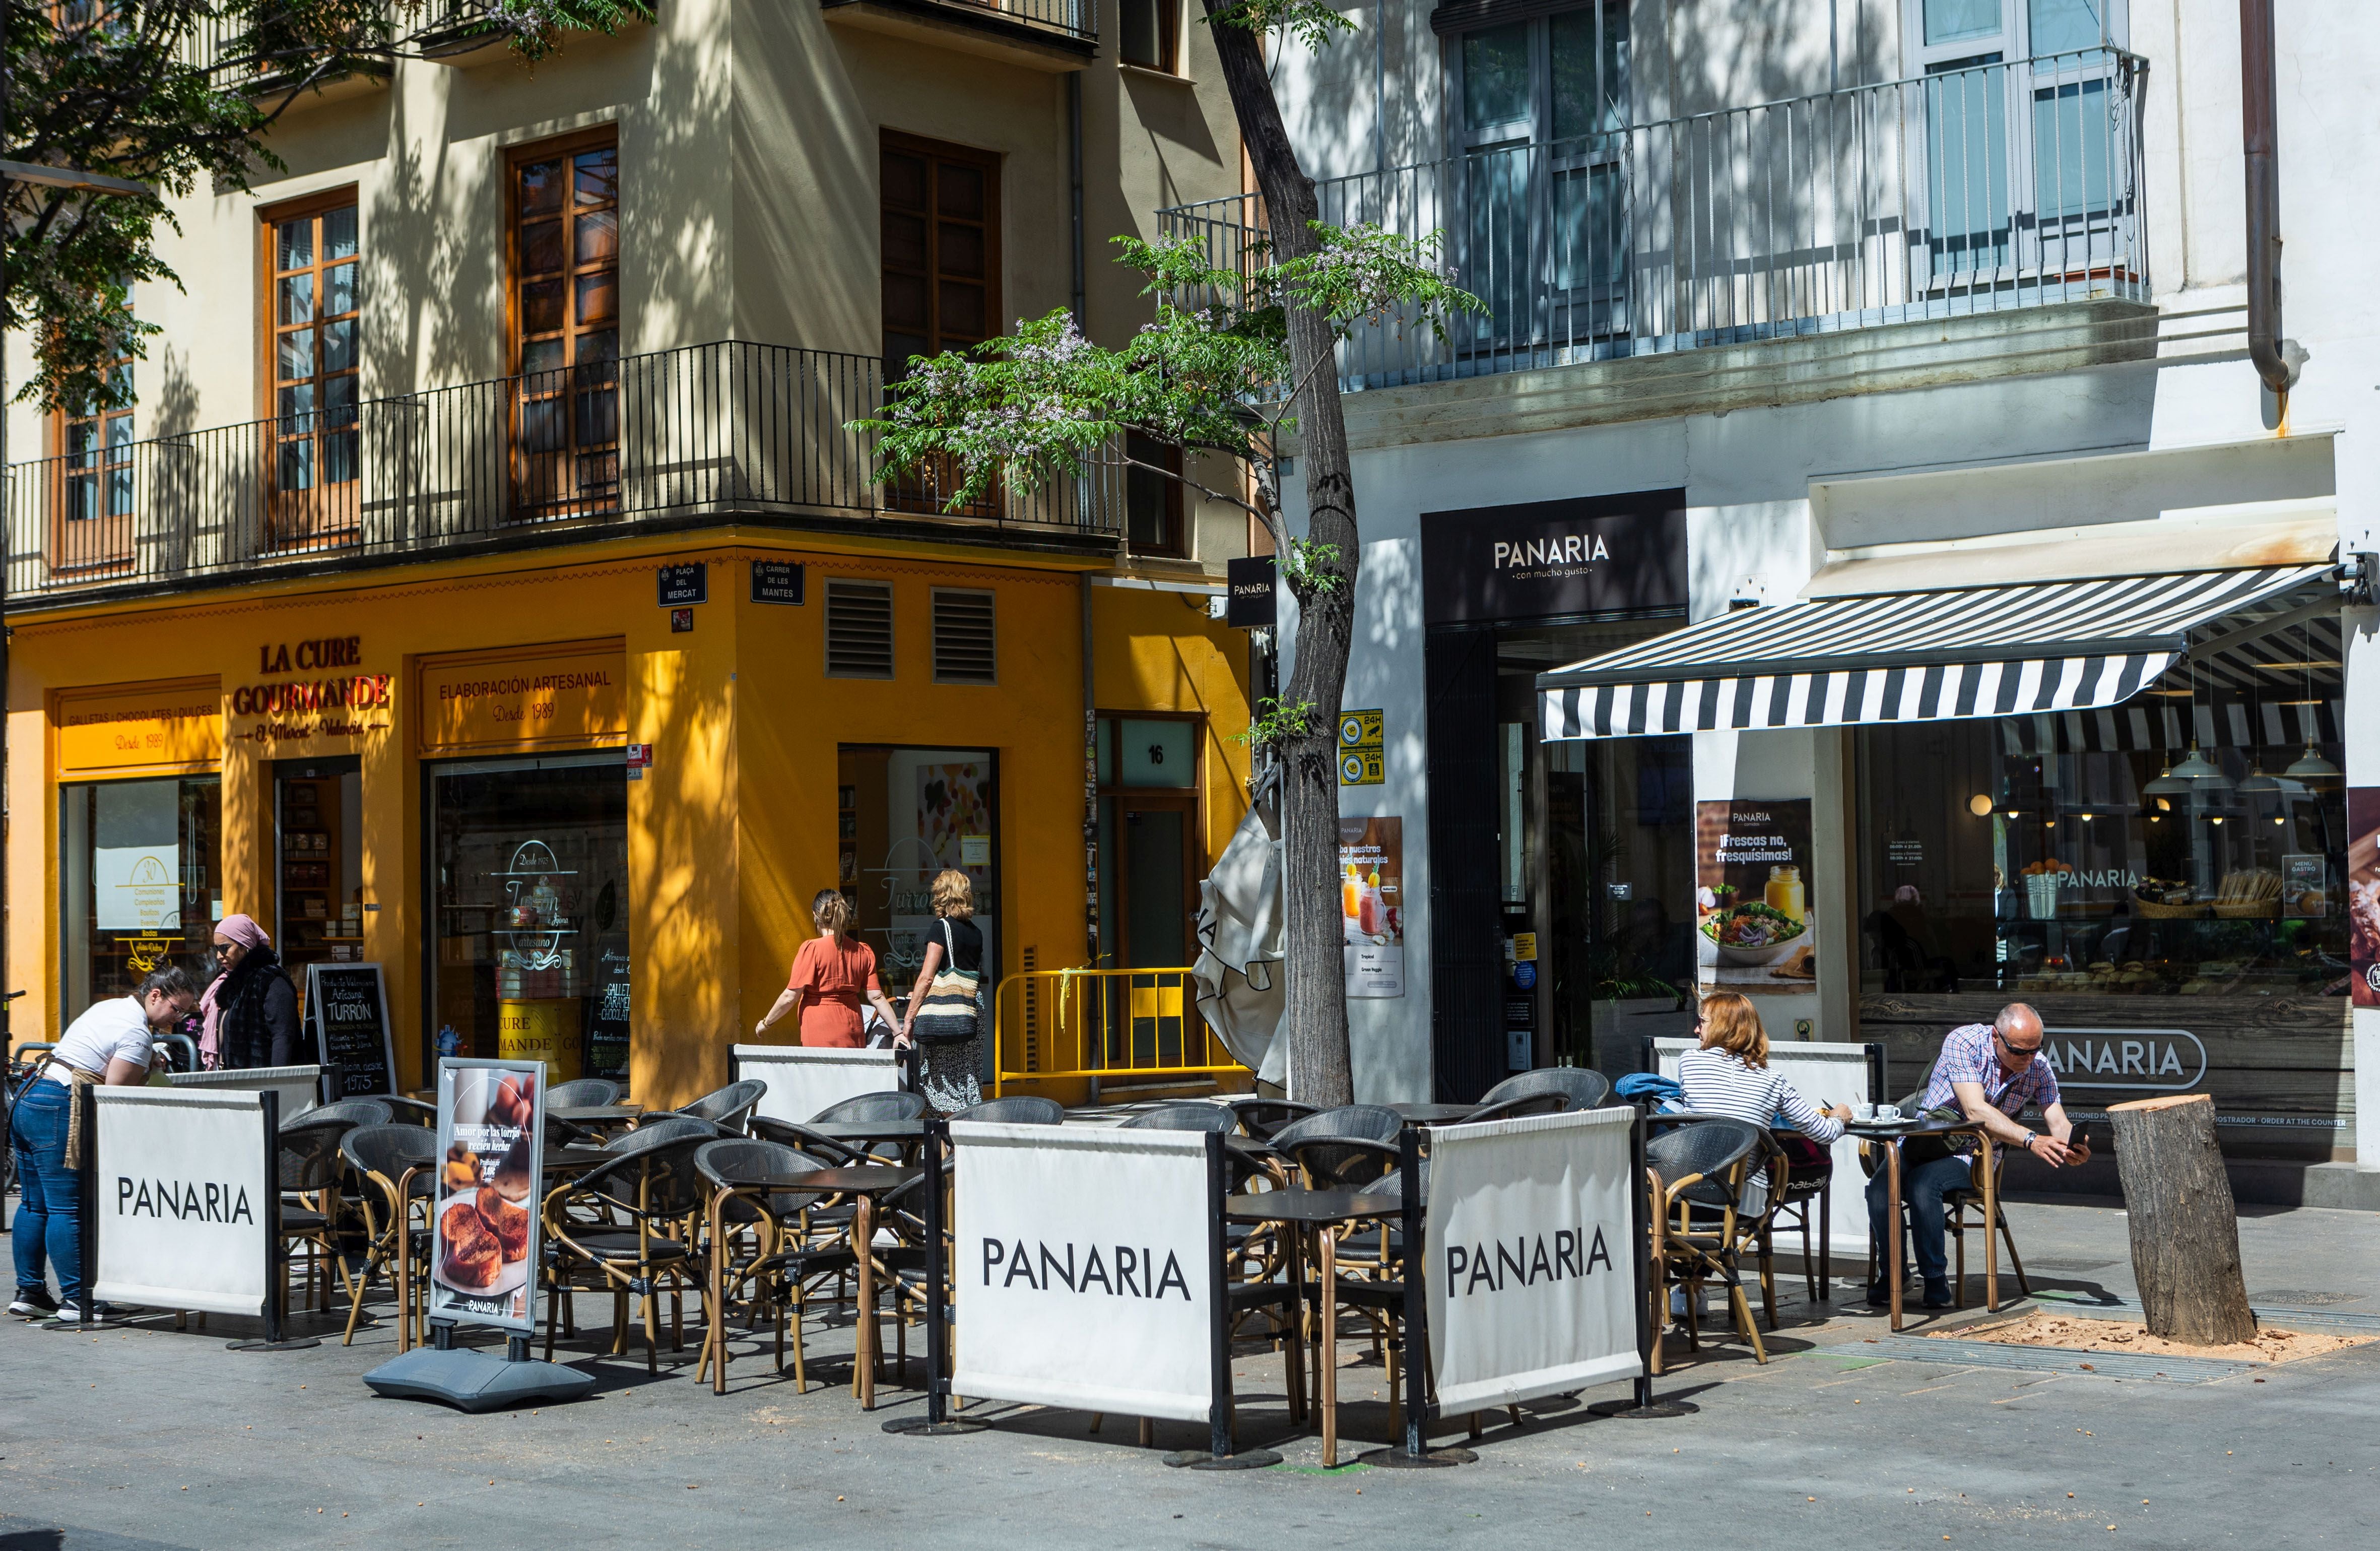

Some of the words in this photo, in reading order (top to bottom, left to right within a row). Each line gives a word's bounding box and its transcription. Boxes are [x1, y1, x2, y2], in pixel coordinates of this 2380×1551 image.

[1495, 534, 1609, 568] PANARIA
[676, 567, 694, 575] PLAÇA
[1534, 568, 1562, 577] mucho
[1565, 567, 1588, 578] gusto
[668, 589, 696, 599] MERCAT
[762, 588, 793, 598] MANTES
[1234, 583, 1270, 595] PANARIA
[259, 644, 292, 674] LA
[295, 635, 361, 670] CURE
[439, 675, 529, 700] ELABORACIÓN
[533, 670, 611, 691] ARTESANAL
[233, 674, 390, 715] GOURMANDE
[69, 713, 109, 726] GALLETAS
[116, 708, 172, 723] CHOCOLATES
[179, 705, 213, 718] DULCES
[493, 704, 525, 722] Desde
[532, 702, 554, 720] 1989
[1364, 716, 1381, 724] 24H
[255, 724, 267, 742] El
[269, 723, 310, 740] Mercat
[319, 719, 364, 736] Valencia
[115, 734, 140, 750] Desde
[146, 733, 164, 748] 1989
[1149, 744, 1163, 764] 16
[1365, 753, 1382, 762] 24H
[1733, 812, 1771, 822] PANARIA
[1720, 834, 1767, 848] ¡Frescas
[1770, 836, 1787, 847] no,
[1349, 845, 1381, 853] nuestros
[519, 853, 537, 866] Desde
[538, 857, 549, 866] 1975
[1339, 855, 1352, 864] hies
[1354, 854, 1388, 864] naturales
[1715, 848, 1792, 865] fresquísimas!
[143, 861, 157, 883] 30
[2058, 869, 2139, 888] PANARIA
[135, 899, 165, 908] Cumpleaños
[518, 934, 550, 947] artesano
[320, 976, 346, 987] Producto
[330, 988, 365, 1000] Artesanal
[607, 983, 630, 997] GALLET
[327, 1000, 372, 1021] TURRÓN
[601, 1008, 630, 1021] CHOCOLAT
[2046, 1040, 2184, 1075] ANARIA
[344, 1074, 372, 1091] 1975
[2311, 1119, 2346, 1127] COUNTER
[454, 1125, 477, 1137] Amor
[477, 1128, 490, 1139] por
[490, 1123, 500, 1137] las
[501, 1126, 520, 1140] torrijas
[468, 1139, 491, 1151] recién
[491, 1140, 511, 1151] hechas
[118, 1177, 253, 1225] PANARIA
[1447, 1223, 1612, 1298] PANARIA
[983, 1238, 1192, 1301] PANARIA
[469, 1300, 498, 1314] PANARIA
